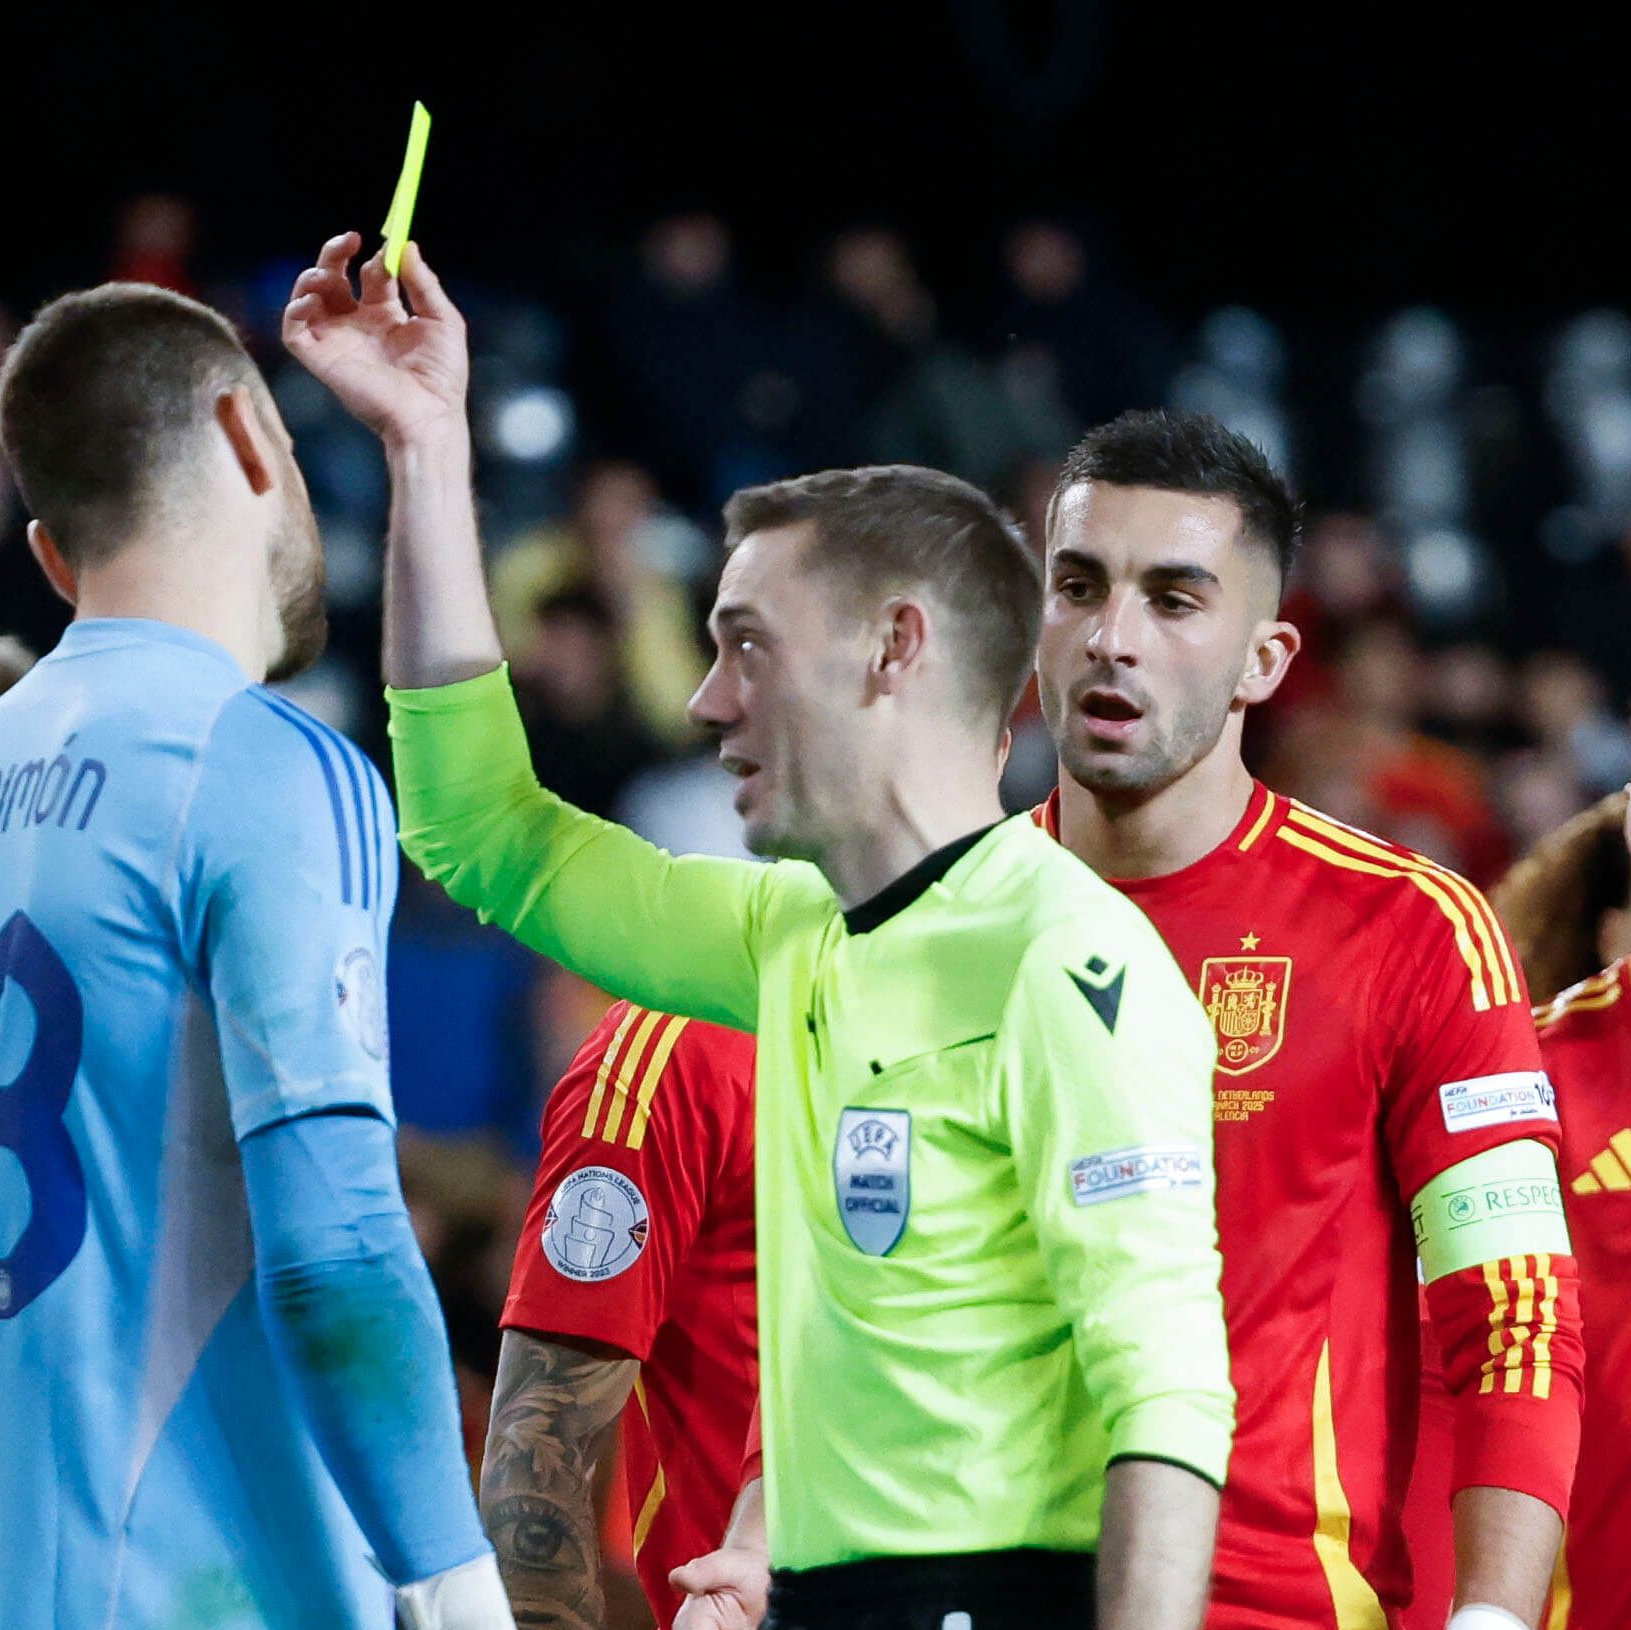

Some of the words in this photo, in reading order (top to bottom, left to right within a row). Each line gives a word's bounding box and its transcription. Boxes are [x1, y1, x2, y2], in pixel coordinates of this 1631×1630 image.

[1218, 1090, 1275, 1102] NETHERLANDS
[1447, 1090, 1535, 1115] FOUNDATION
[1242, 1101, 1265, 1111] 2025
[1215, 1111, 1250, 1121] ALENCIA
[1074, 1156, 1200, 1190] FOUNDATION
[1485, 1184, 1561, 1212] RESPEC
